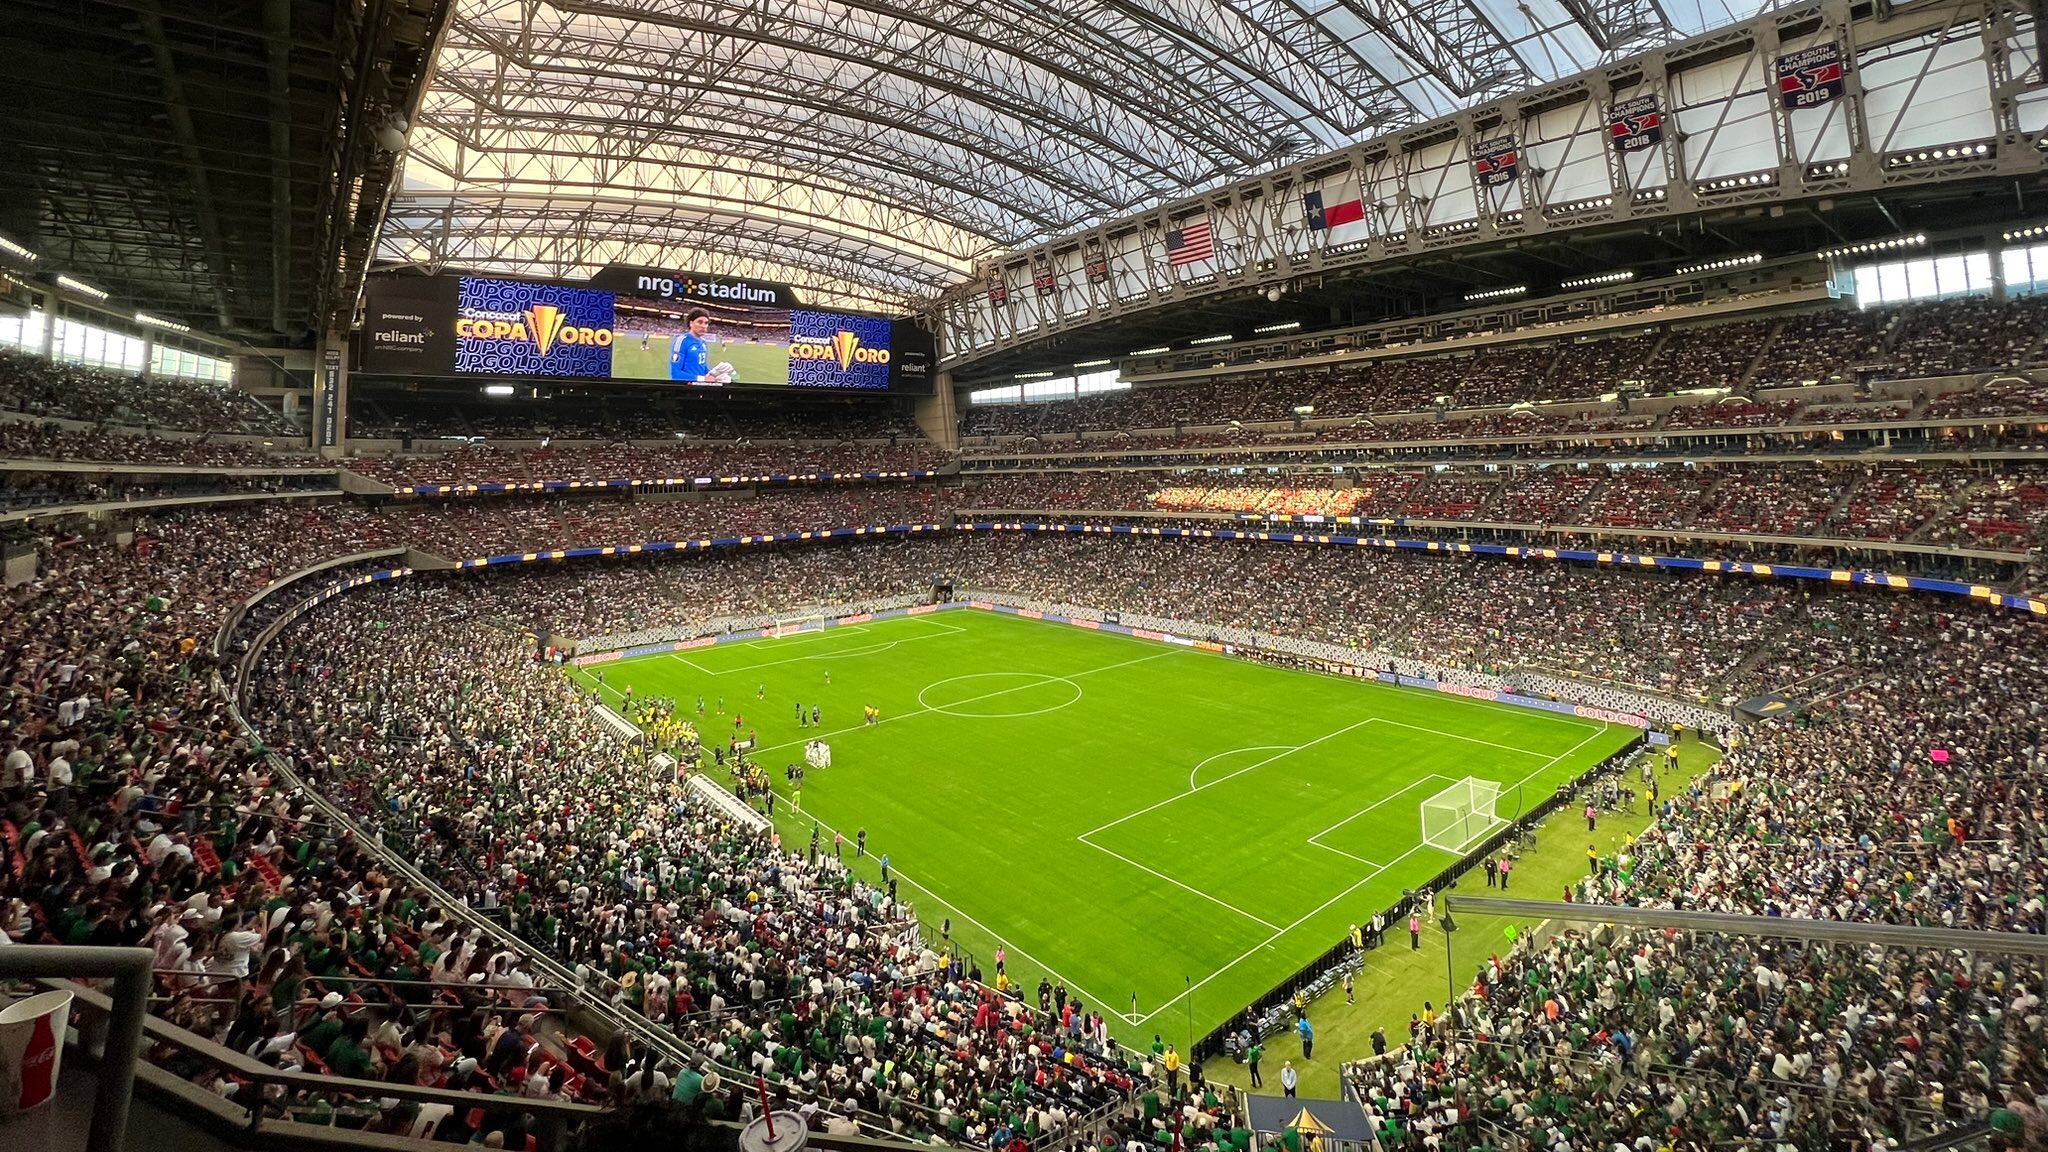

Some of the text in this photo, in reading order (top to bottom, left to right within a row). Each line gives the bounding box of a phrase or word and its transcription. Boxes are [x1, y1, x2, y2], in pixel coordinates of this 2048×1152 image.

[1779, 50, 1837, 73] CHAMPIONS
[1784, 46, 1830, 64] AFC SOUTH
[1627, 98, 1650, 109] SOUTH
[1796, 87, 1830, 106] 2019
[1609, 101, 1655, 120] CHAMPIONS
[1623, 134, 1650, 150] 2018
[1487, 171, 1509, 184] 2016
[638, 275, 776, 303] nrg stadium
[382, 313, 413, 321] powered
[464, 307, 521, 321] Concacaf
[375, 330, 425, 344] reliant
[456, 319, 613, 346] COPA ORO
[788, 342, 891, 364] COPA ORO
[901, 362, 926, 373] reliant
[1437, 681, 1498, 701] GOLDCUP
[1574, 705, 1647, 729] GOLDCUP
